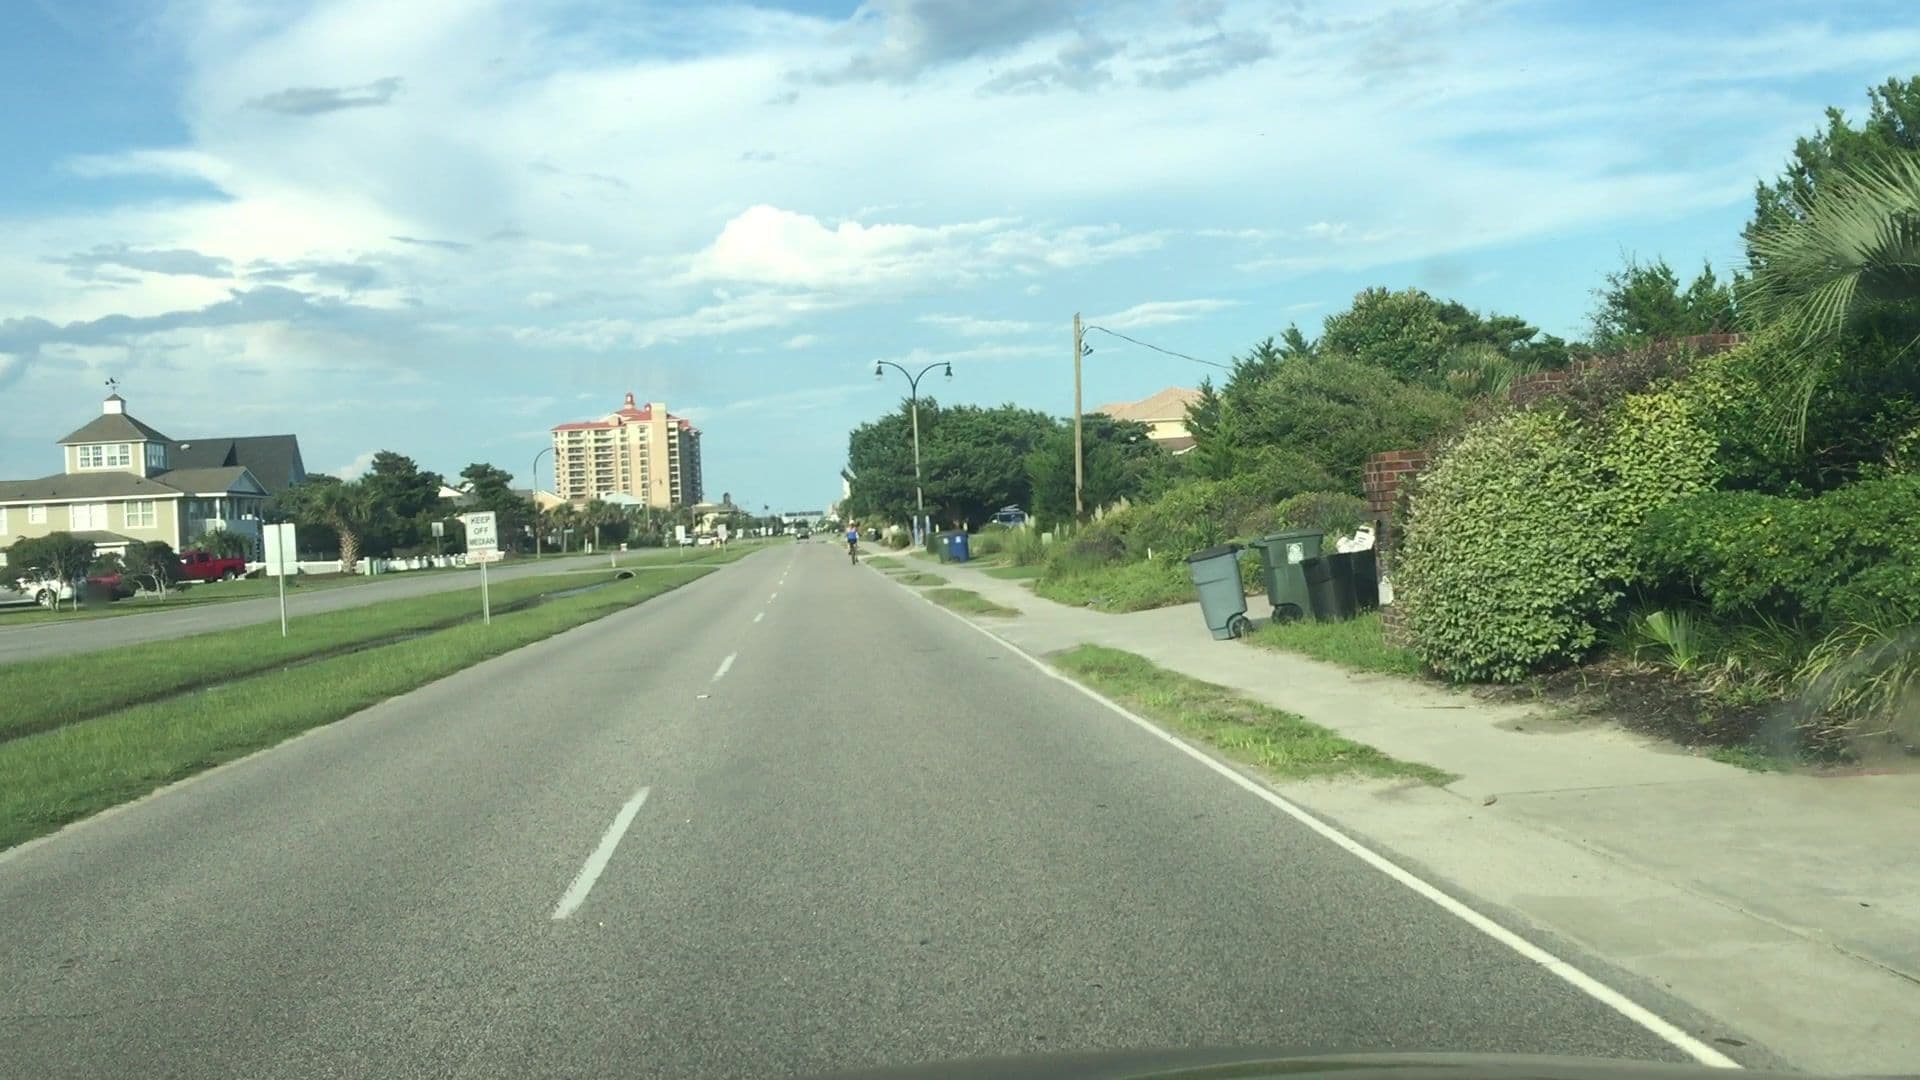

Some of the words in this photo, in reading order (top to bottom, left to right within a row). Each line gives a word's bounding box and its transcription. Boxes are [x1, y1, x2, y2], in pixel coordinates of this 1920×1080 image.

[471, 516, 490, 525] KEEP
[473, 527, 488, 535] OFF
[469, 537, 495, 546] MEDIAN
